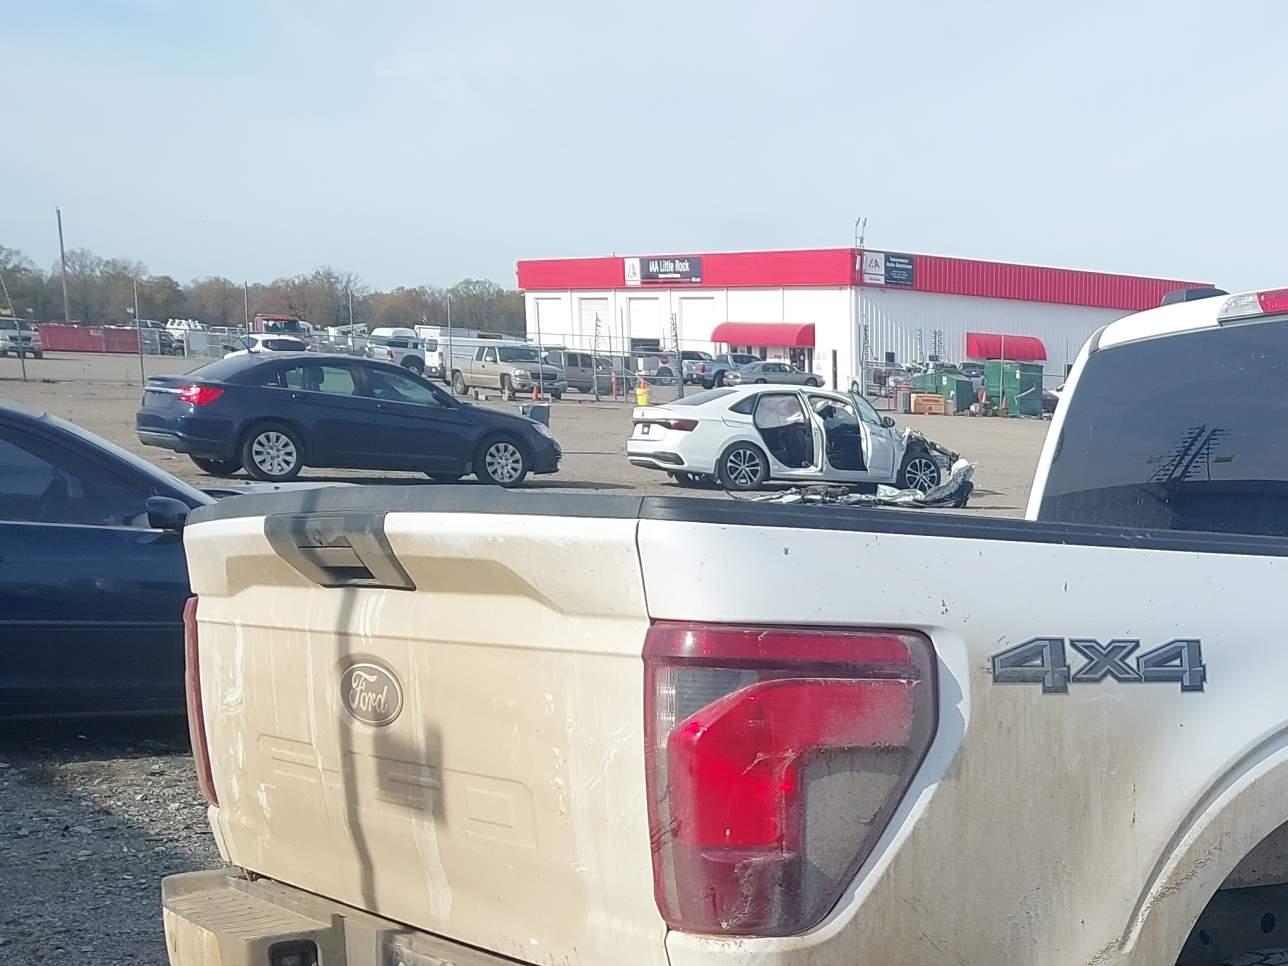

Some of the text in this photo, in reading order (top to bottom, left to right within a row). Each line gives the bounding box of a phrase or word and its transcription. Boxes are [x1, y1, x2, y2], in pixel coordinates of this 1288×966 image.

[660, 260, 674, 272] Little
[675, 259, 690, 272] Rock
[349, 670, 389, 714] Ford
